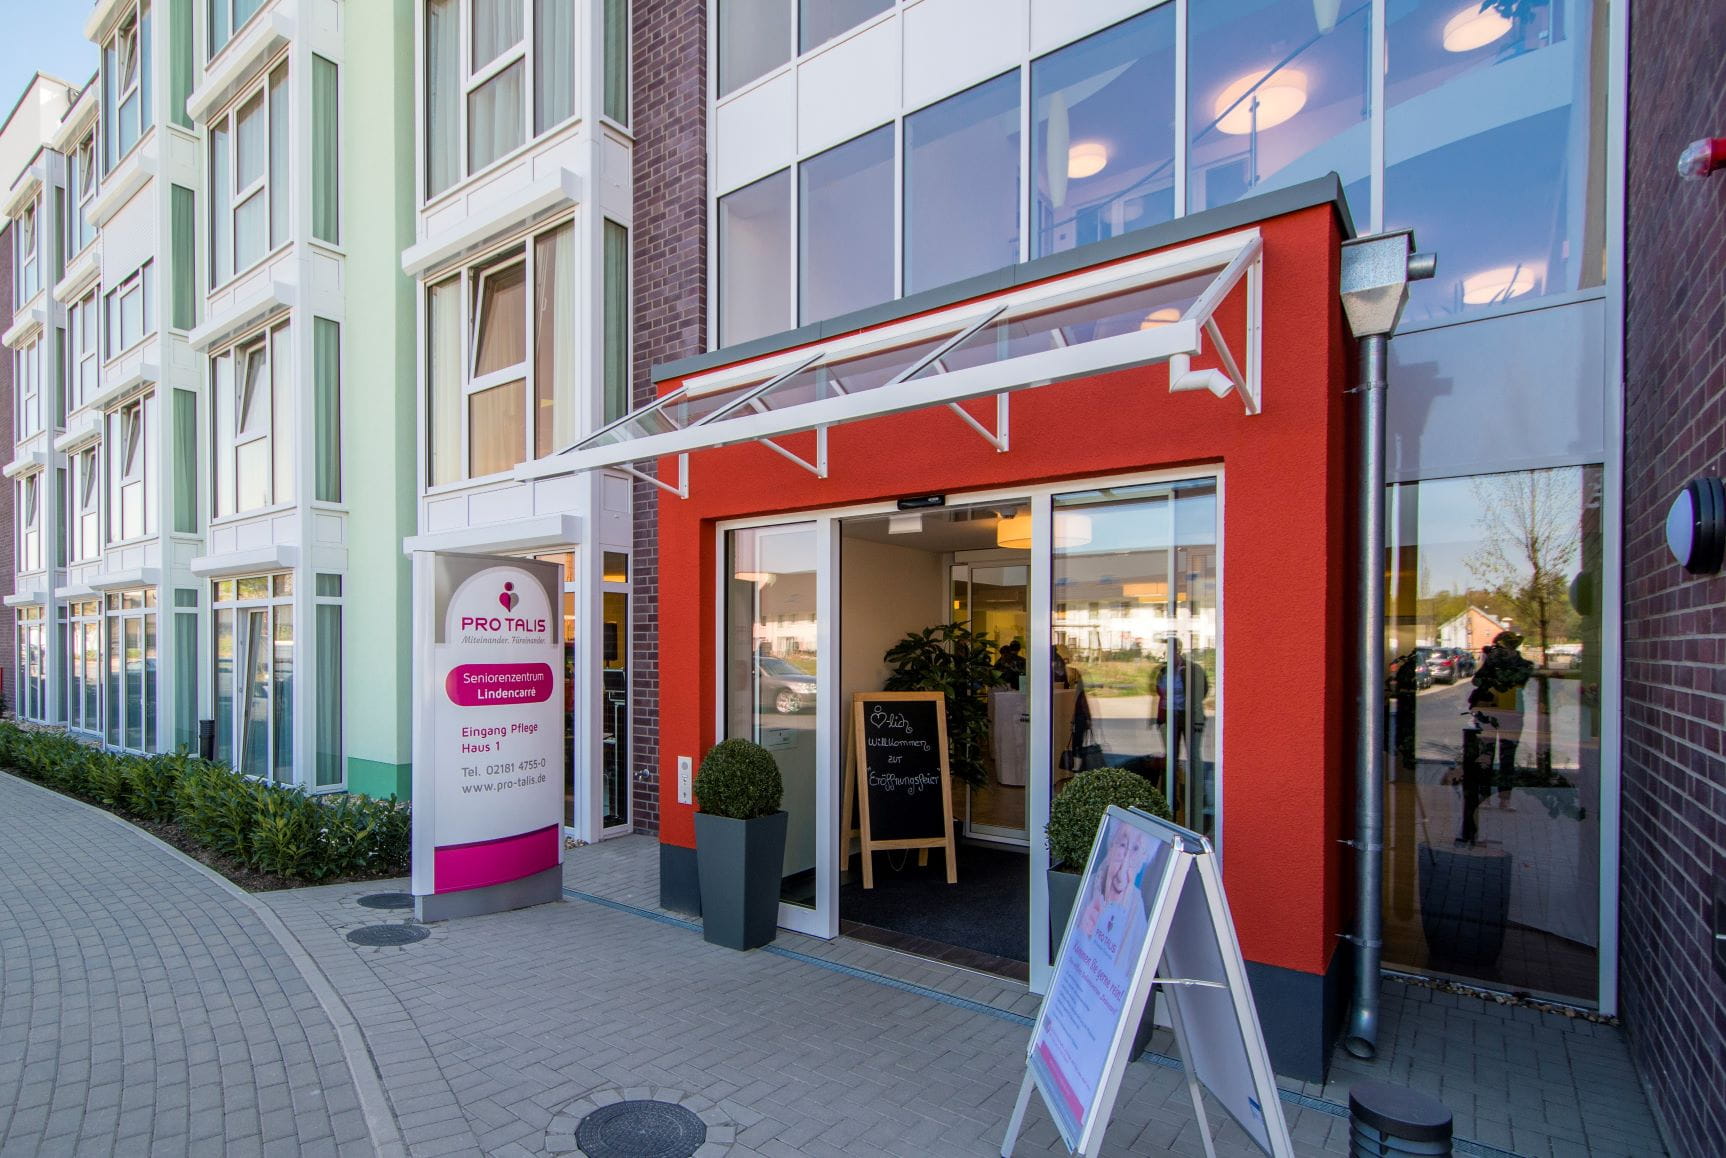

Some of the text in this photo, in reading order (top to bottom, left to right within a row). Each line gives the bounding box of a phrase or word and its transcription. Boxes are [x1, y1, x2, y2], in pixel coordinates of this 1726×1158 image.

[461, 617, 546, 633] PRO TALIS
[461, 635, 510, 645] Miteinander.
[463, 672, 545, 684] Seniorenzentrum
[477, 686, 537, 700] Lindencarré
[462, 722, 538, 739] Eingang Pflege
[462, 741, 501, 754] Haus 1
[461, 757, 546, 778] Tel. 02181 4755-0
[462, 774, 546, 794] www.pro-talis.de
